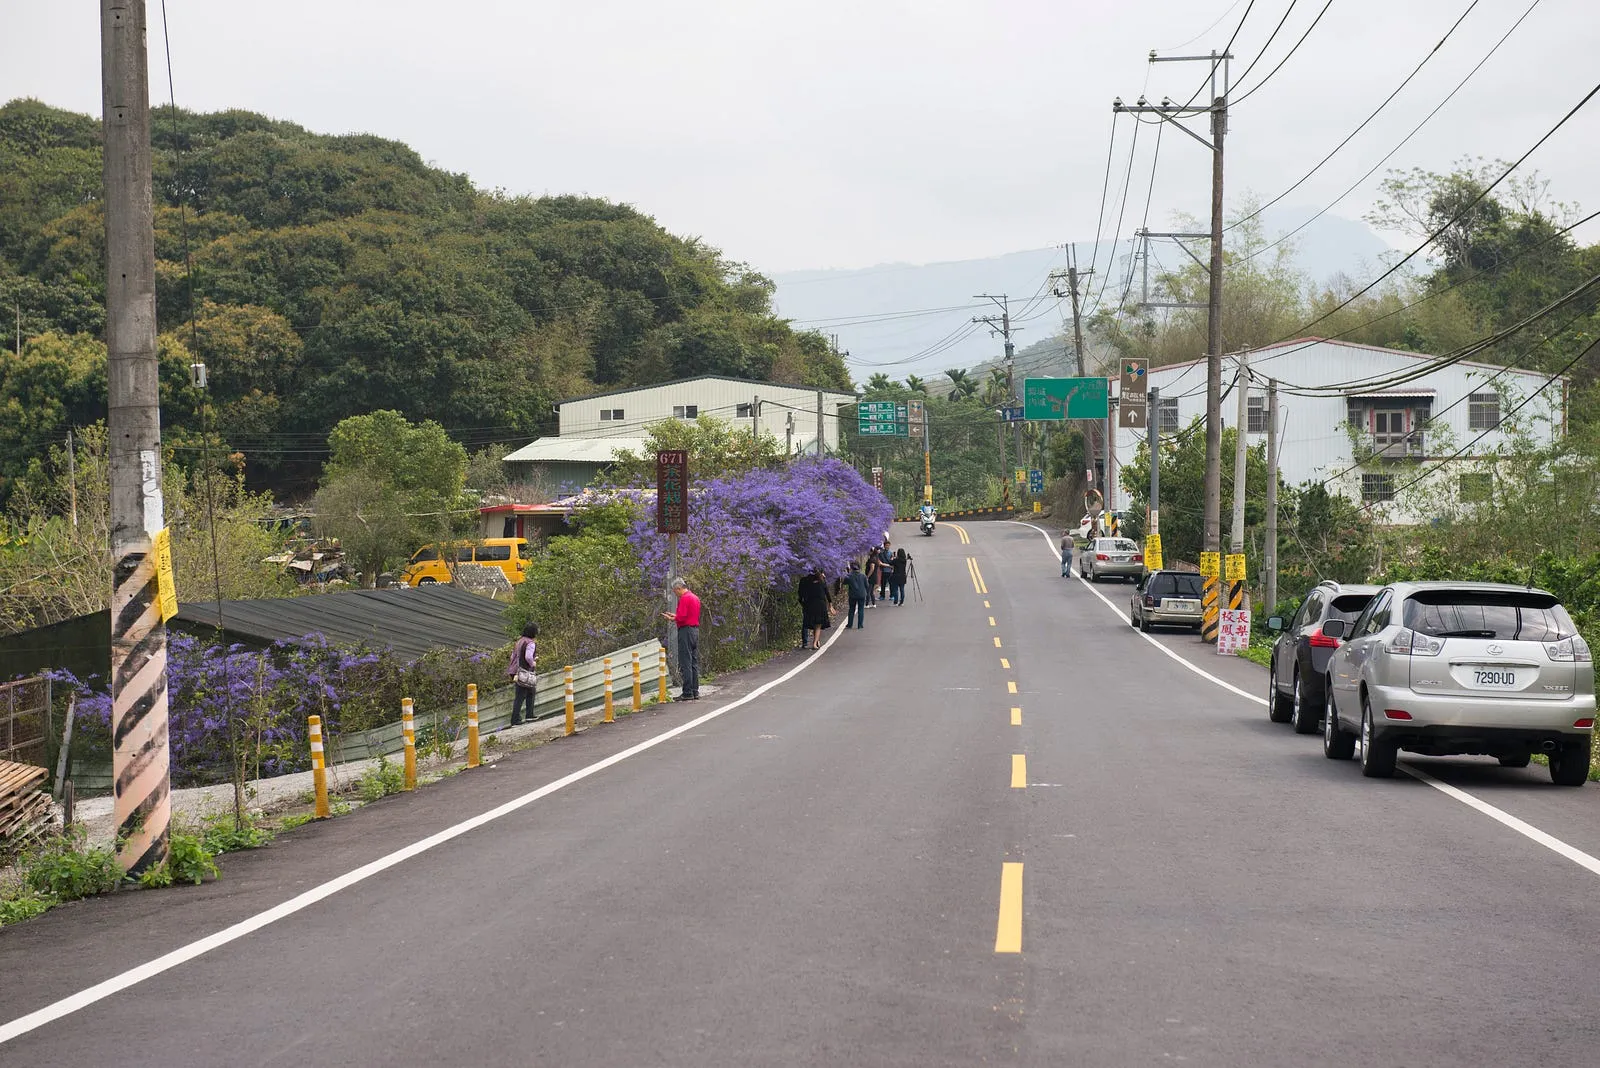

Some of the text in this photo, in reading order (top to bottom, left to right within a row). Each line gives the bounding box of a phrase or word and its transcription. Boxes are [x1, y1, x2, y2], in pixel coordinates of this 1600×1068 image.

[660, 453, 683, 464] 671
[1222, 611, 1249, 623] 校長
[1221, 624, 1248, 637] 鳳梨
